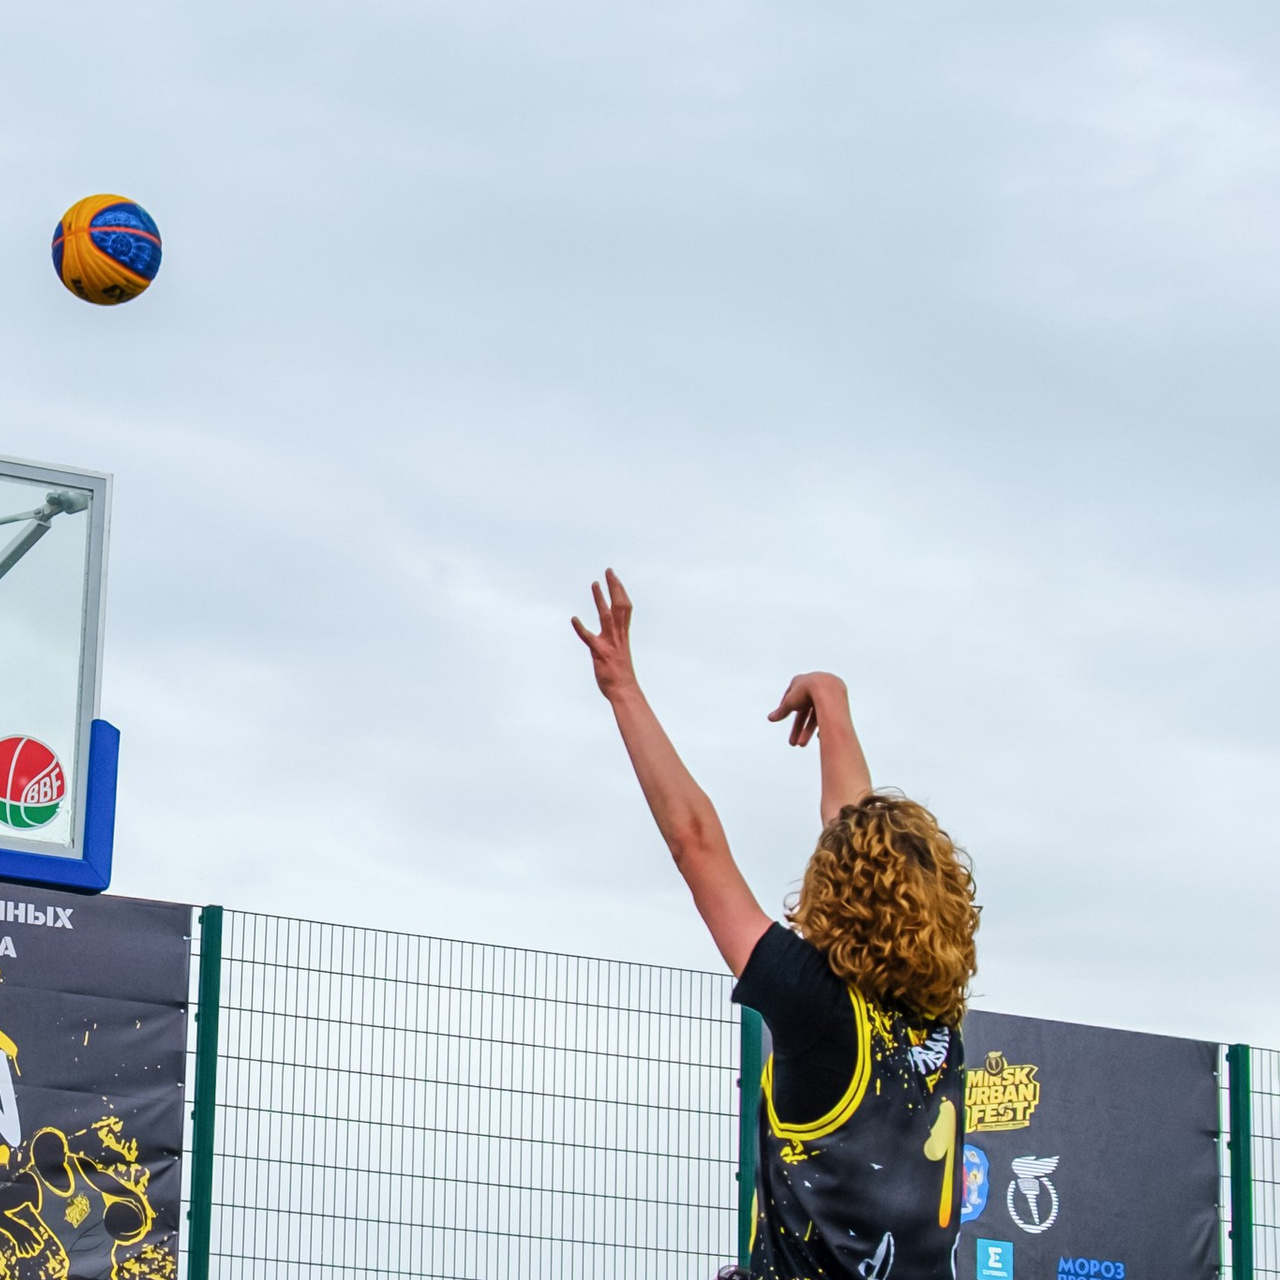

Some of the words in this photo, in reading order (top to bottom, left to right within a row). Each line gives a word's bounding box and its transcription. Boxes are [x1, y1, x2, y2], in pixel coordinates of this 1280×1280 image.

[25, 766, 62, 804] BBF
[966, 1067, 1031, 1088] MINSK
[965, 1083, 1035, 1106] URBAN
[970, 1101, 1029, 1128] FEST
[1058, 1256, 1125, 1279] МОРОЗ
